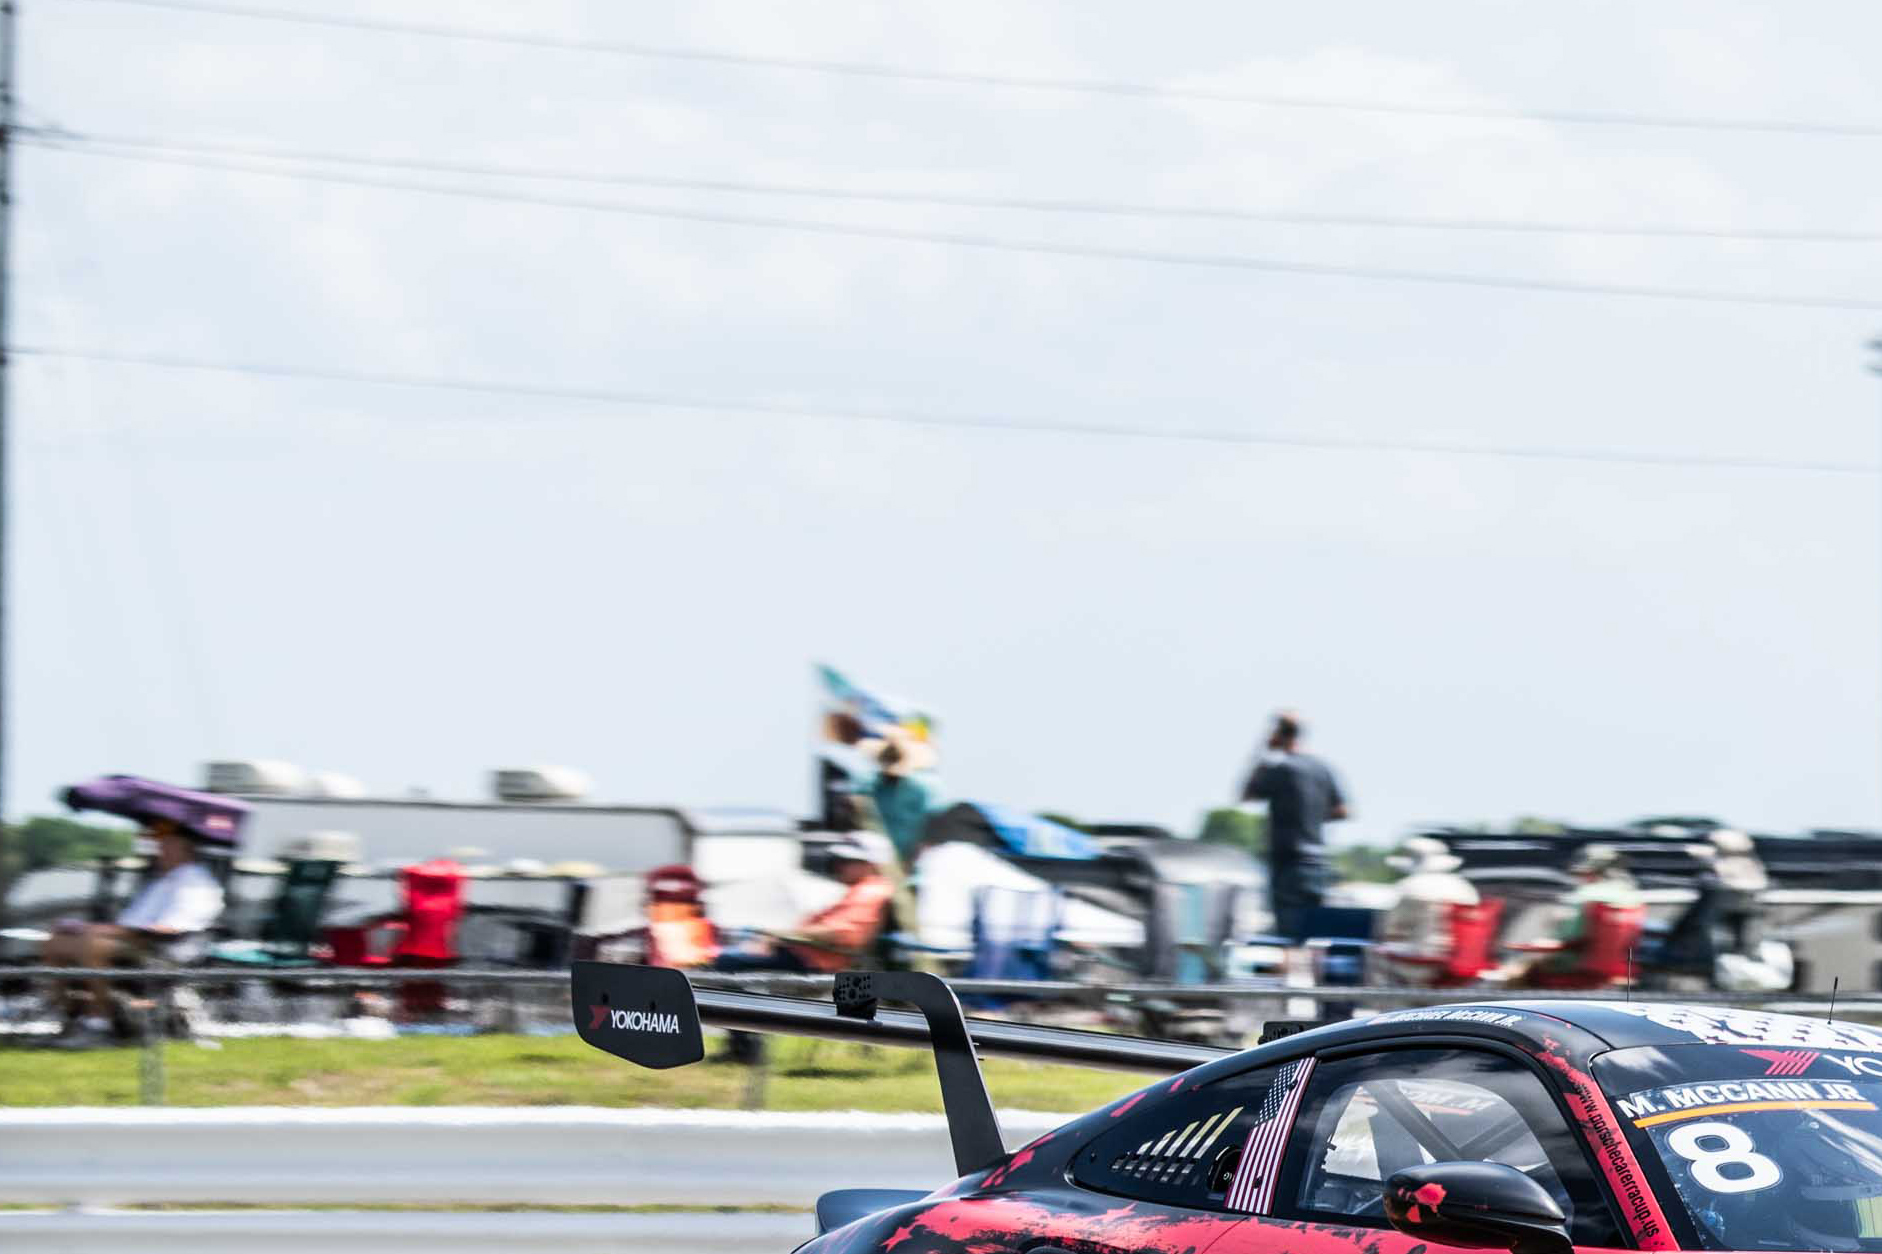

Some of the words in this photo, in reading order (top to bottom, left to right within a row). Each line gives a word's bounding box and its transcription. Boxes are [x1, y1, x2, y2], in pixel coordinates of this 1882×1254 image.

[611, 1009, 680, 1034] YOKOHAMA
[1616, 1095, 1665, 1118] M.
[1664, 1082, 1815, 1106] MCCANN
[1816, 1082, 1867, 1102] JR
[1668, 1121, 1783, 1194] 8
